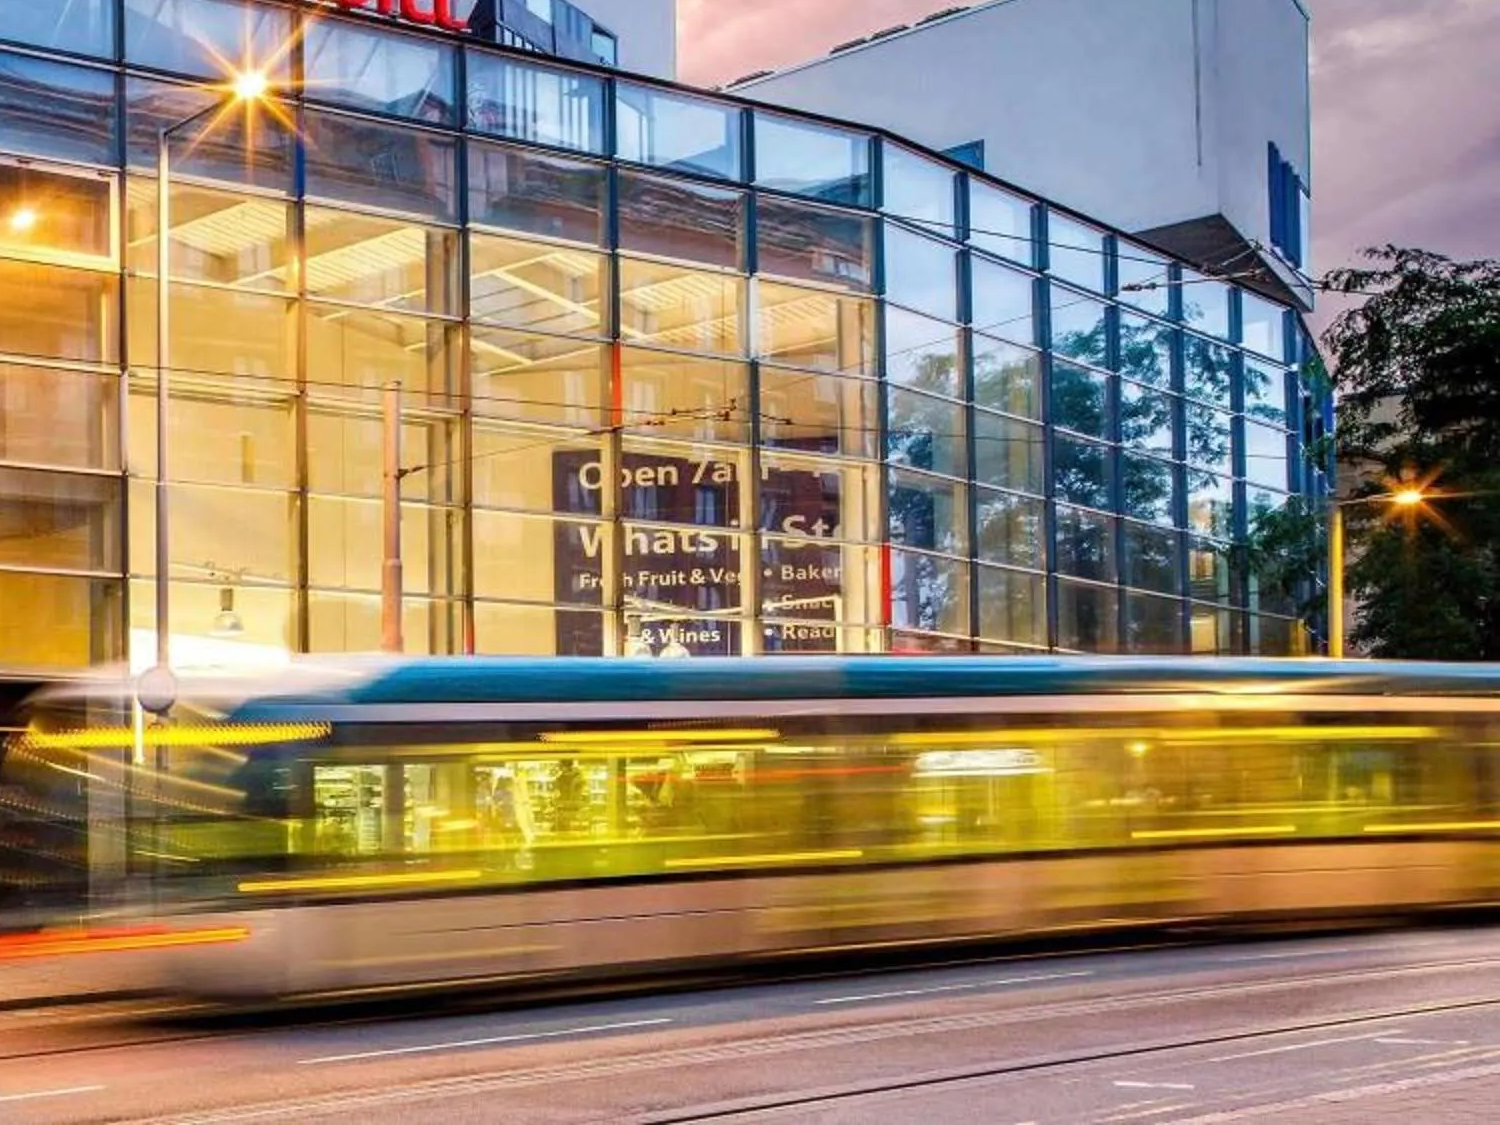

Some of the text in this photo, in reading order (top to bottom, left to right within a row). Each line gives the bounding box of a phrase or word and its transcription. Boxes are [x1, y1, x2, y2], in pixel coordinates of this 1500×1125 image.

[579, 572, 633, 589] Frh
[638, 570, 686, 586] Fruit
[690, 568, 706, 583] &
[641, 628, 655, 644] &
